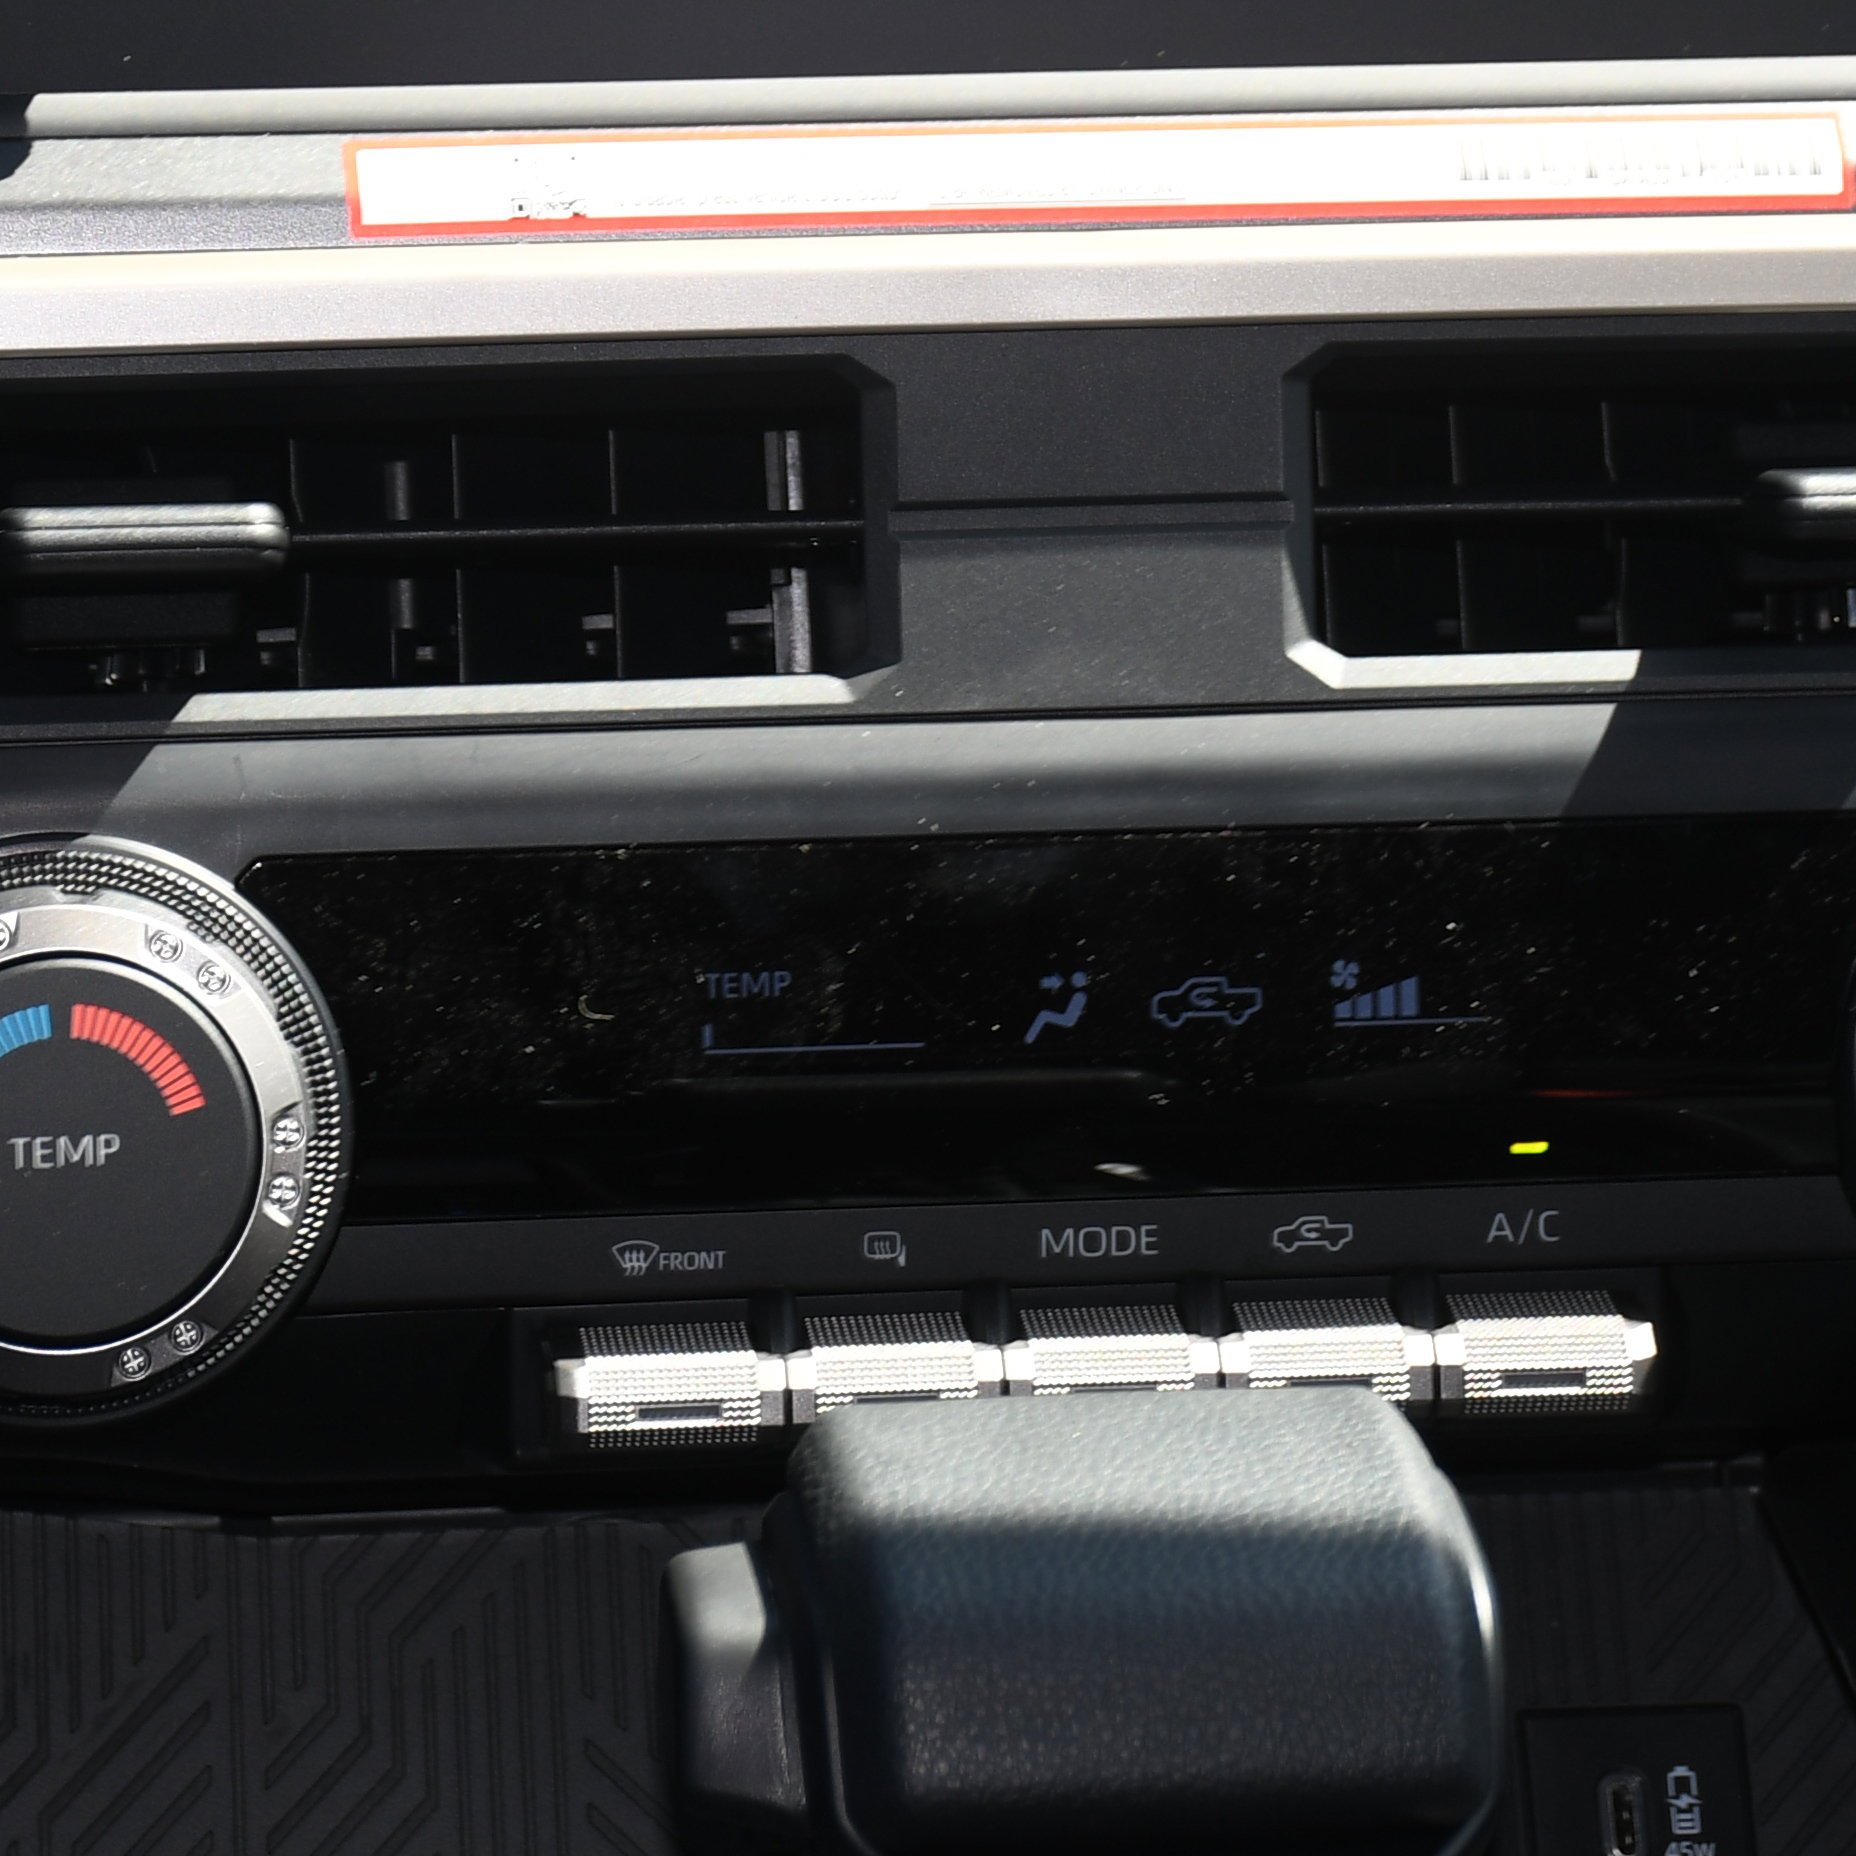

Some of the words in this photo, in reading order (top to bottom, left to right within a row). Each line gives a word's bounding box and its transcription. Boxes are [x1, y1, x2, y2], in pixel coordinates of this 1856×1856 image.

[705, 969, 793, 1001] TEMP
[7, 1133, 121, 1171] TEMP
[1040, 1224, 1159, 1260] MODE
[1486, 1208, 1561, 1244] A/C
[659, 1248, 727, 1272] FRONT
